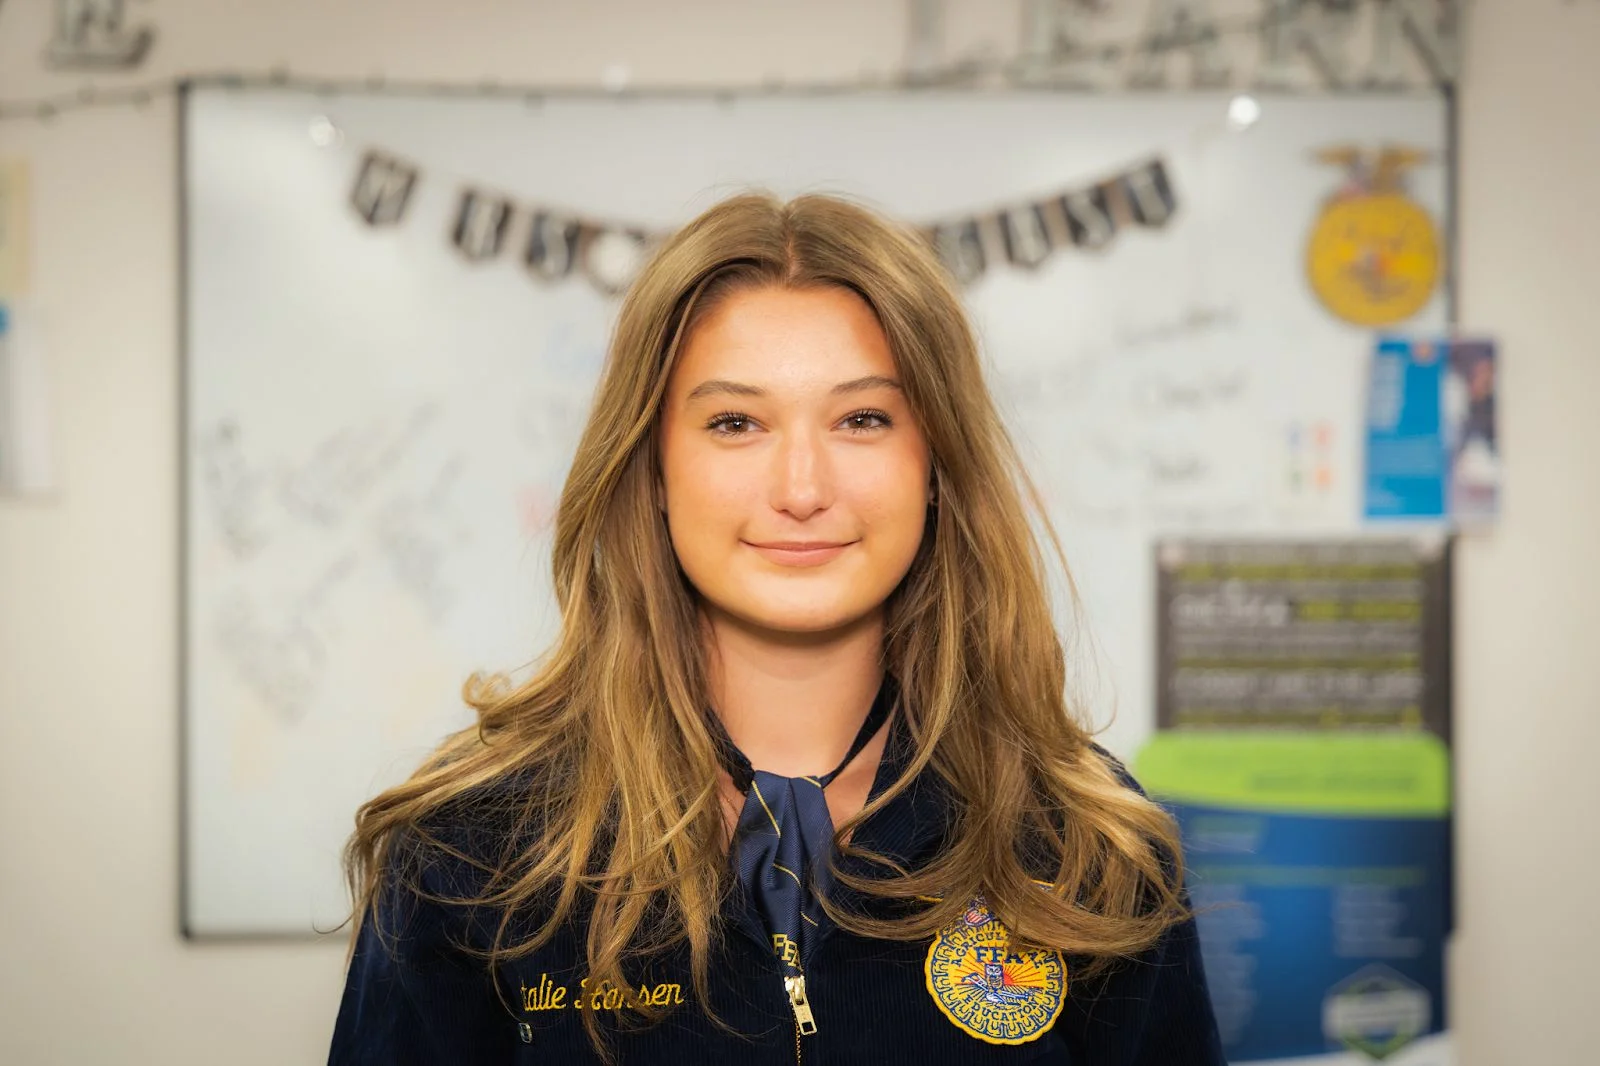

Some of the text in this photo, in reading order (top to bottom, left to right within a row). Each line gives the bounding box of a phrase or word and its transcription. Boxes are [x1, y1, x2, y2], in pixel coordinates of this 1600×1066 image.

[772, 933, 804, 972] FFA
[974, 946, 1024, 964] FFA
[520, 973, 567, 1012] talie
[963, 994, 1040, 1021] EDUCATION
